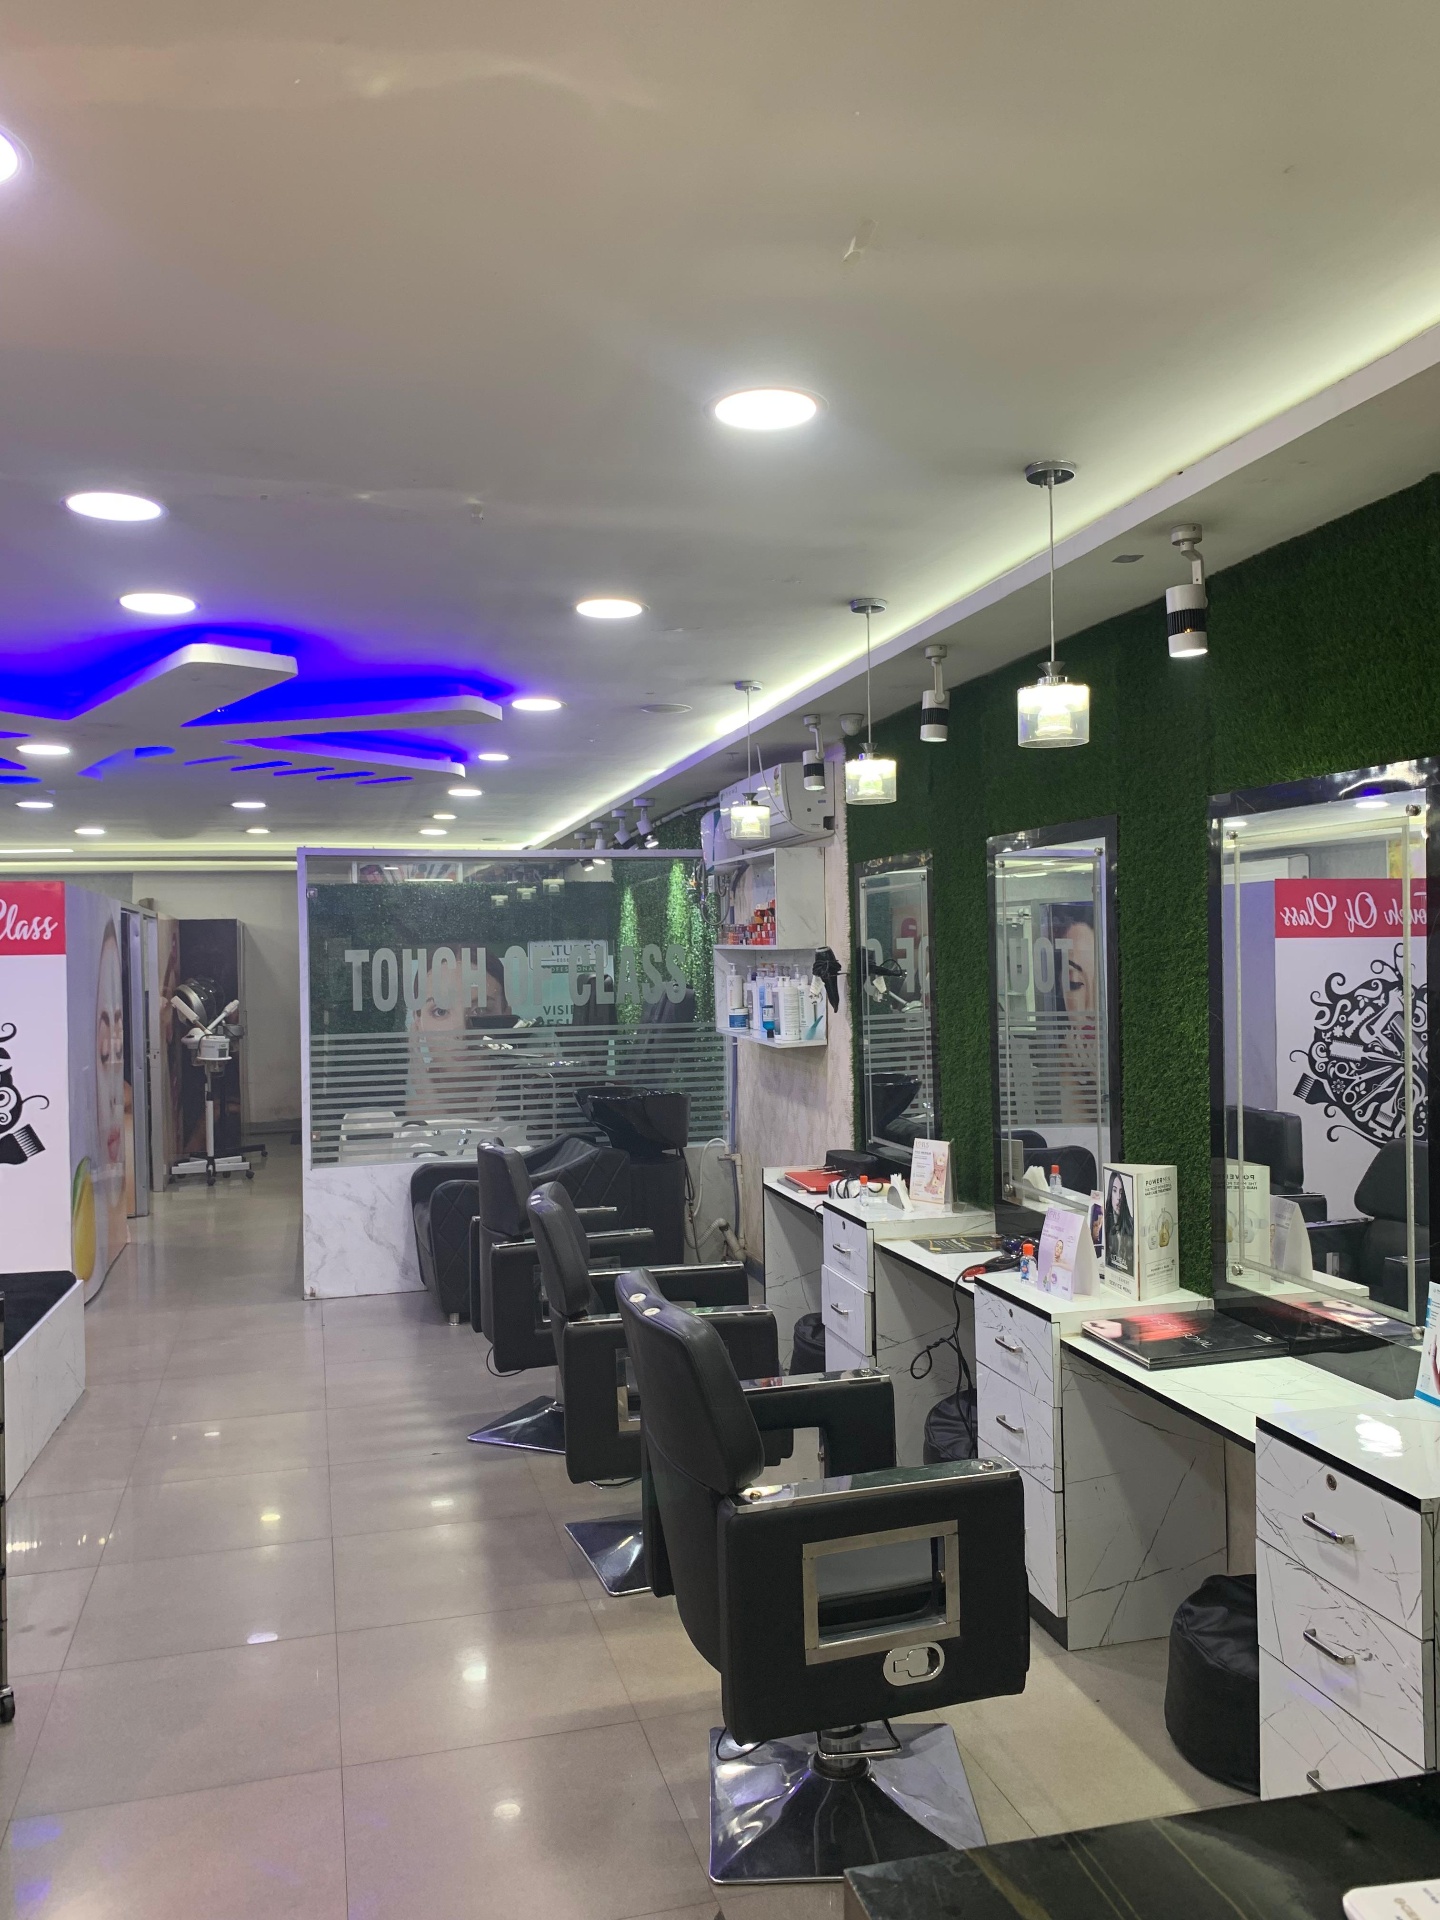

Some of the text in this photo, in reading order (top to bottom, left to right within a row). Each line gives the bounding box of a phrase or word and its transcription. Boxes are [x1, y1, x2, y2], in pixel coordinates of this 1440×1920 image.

[344, 943, 687, 1012] TOUCH OF CLASS
